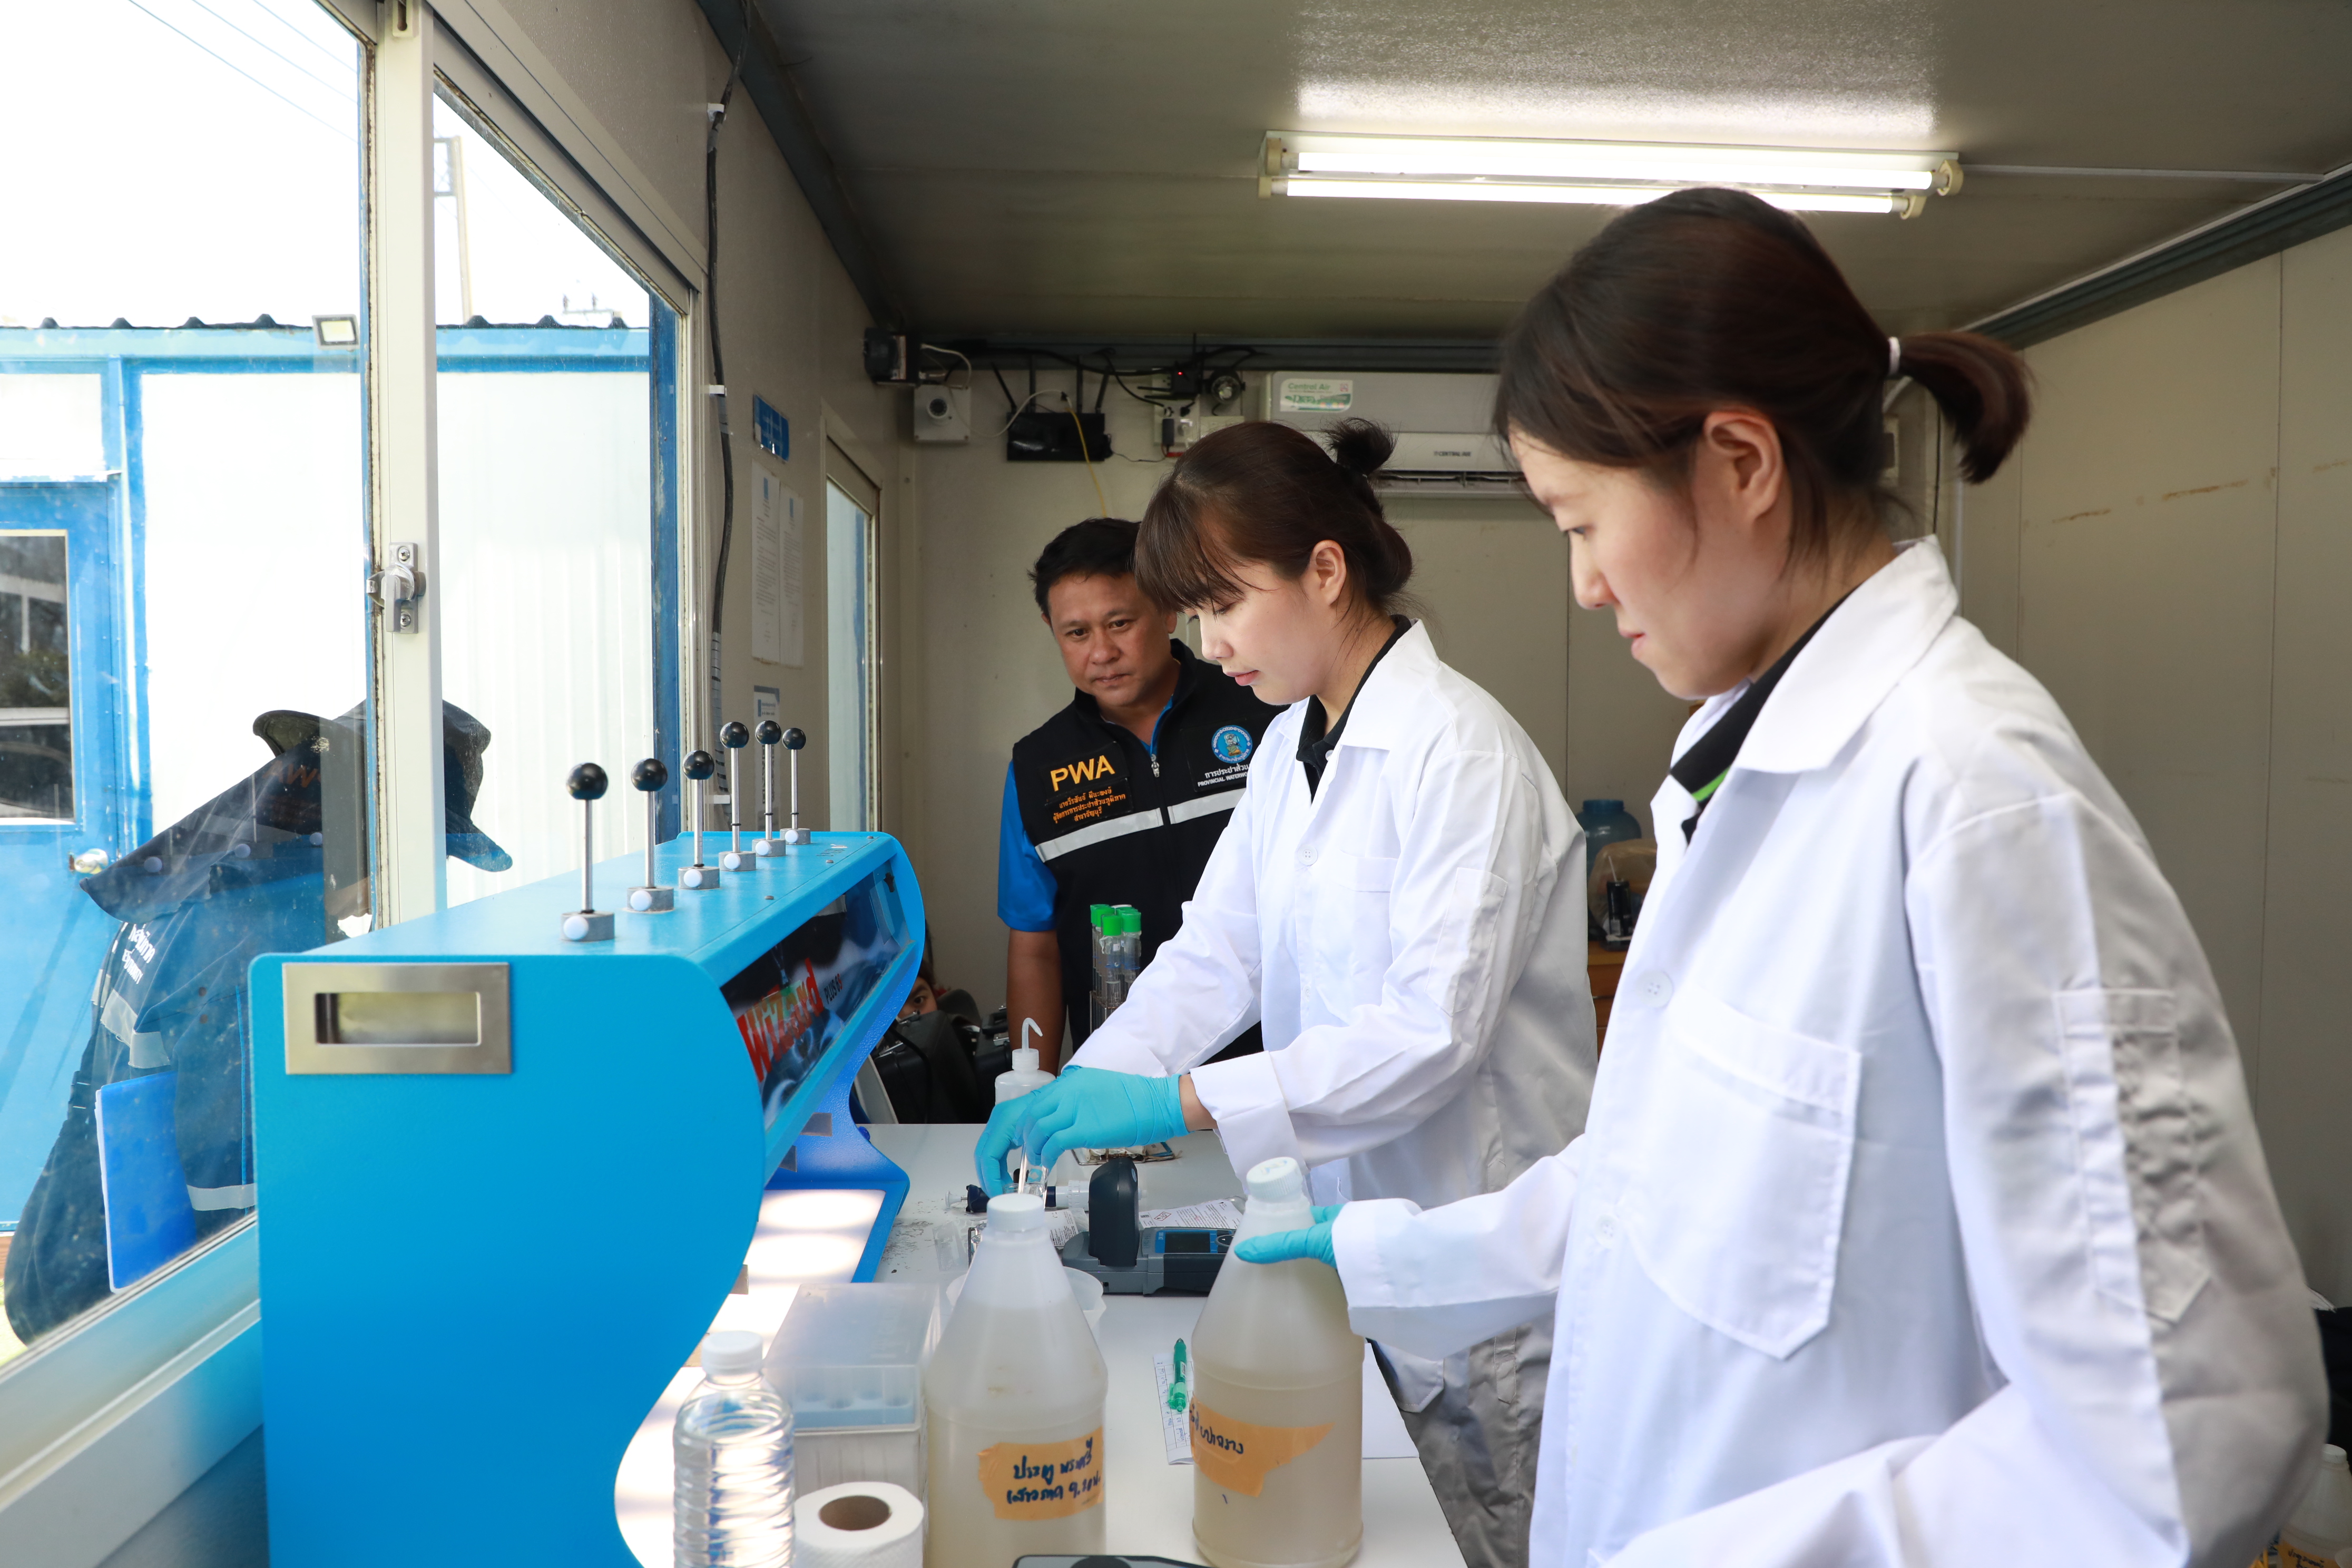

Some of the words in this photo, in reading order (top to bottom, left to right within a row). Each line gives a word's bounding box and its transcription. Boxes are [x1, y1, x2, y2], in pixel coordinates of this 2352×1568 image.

[1050, 755, 1115, 792] PWA
[1197, 777, 1226, 787] PROVINCIAL
[1226, 771, 1248, 781] WATERWO
[1204, 763, 1250, 779] การประปาส่วน
[737, 957, 824, 1083] Wizard
[824, 979, 837, 1005] PLUS
